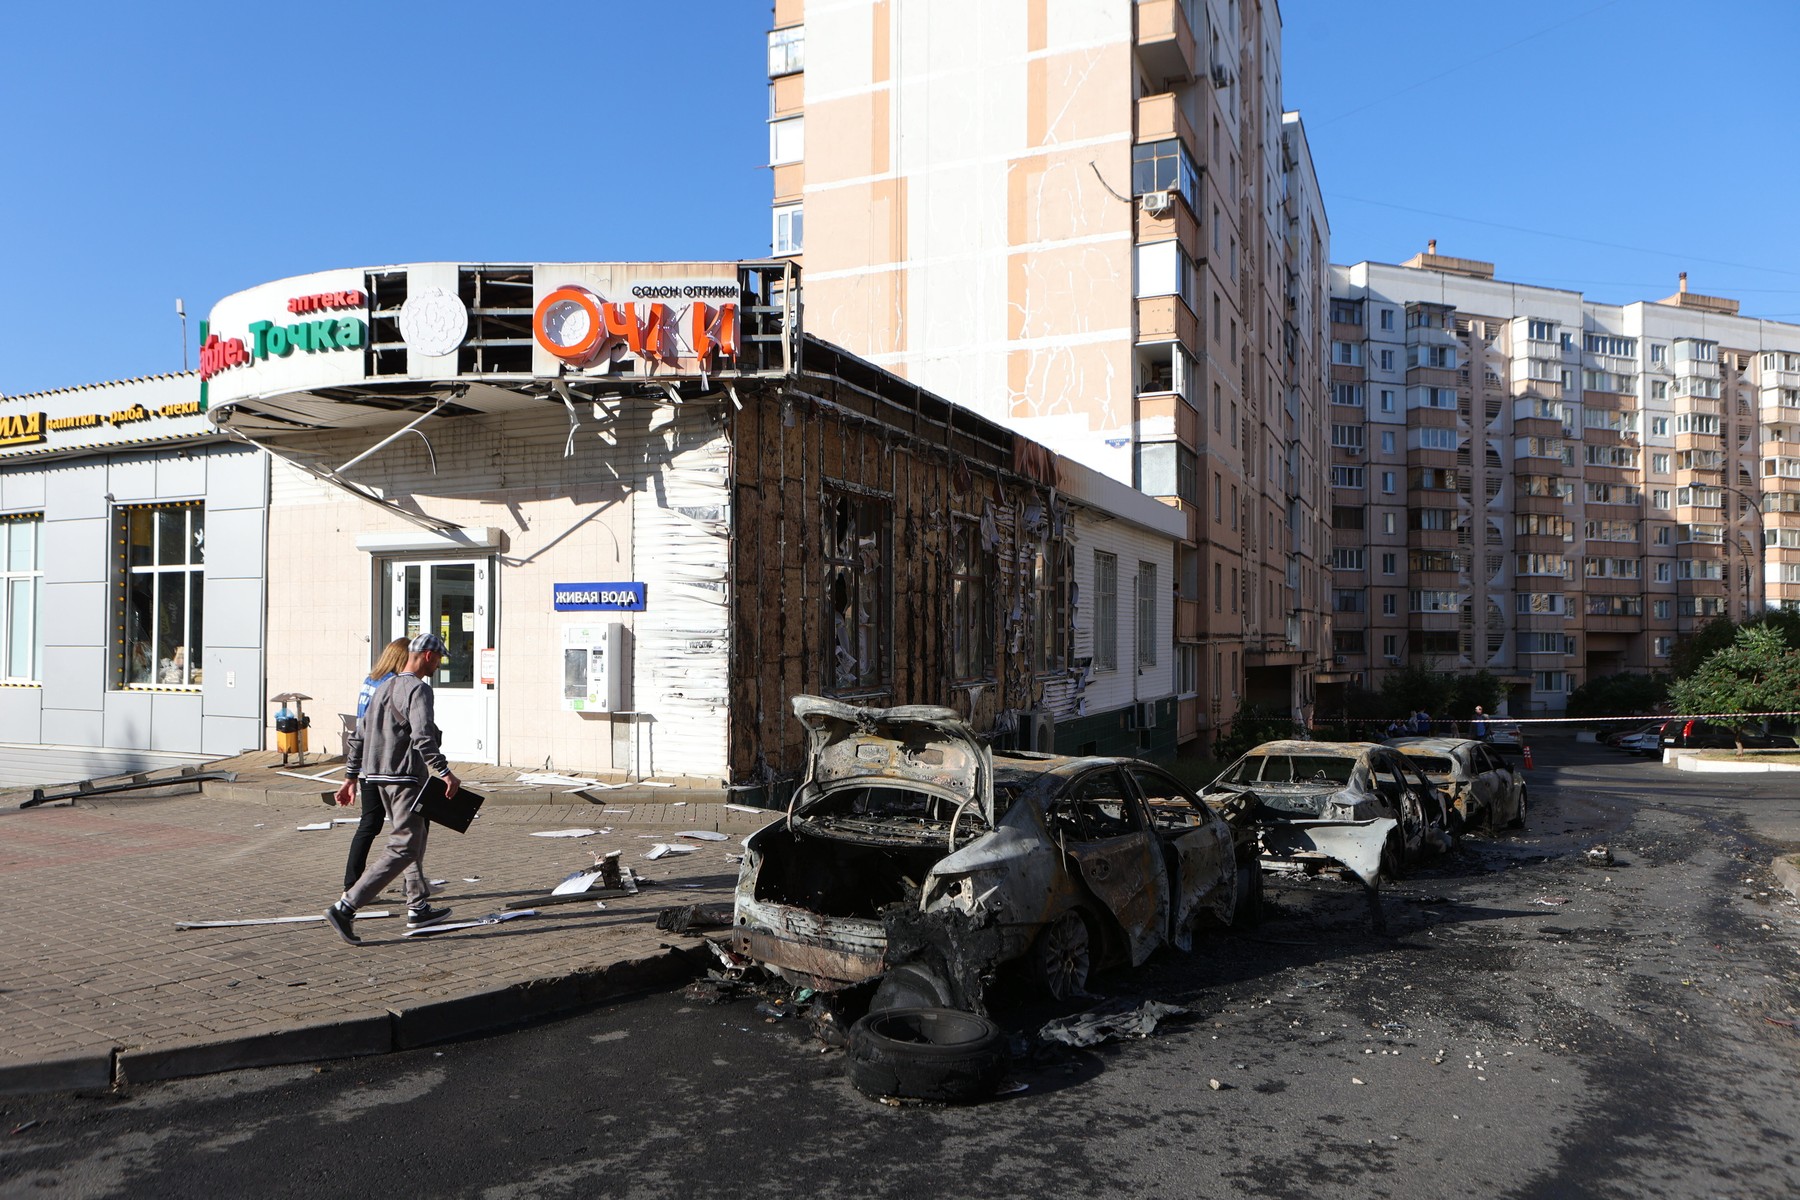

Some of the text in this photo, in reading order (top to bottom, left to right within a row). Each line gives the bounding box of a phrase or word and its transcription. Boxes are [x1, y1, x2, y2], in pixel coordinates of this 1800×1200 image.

[287, 290, 362, 313] аптека
[47, 413, 97, 430] напитки
[109, 404, 144, 425] рыба
[158, 401, 199, 417] снеки
[556, 591, 636, 606] ЖИВАЯ ВОДА
